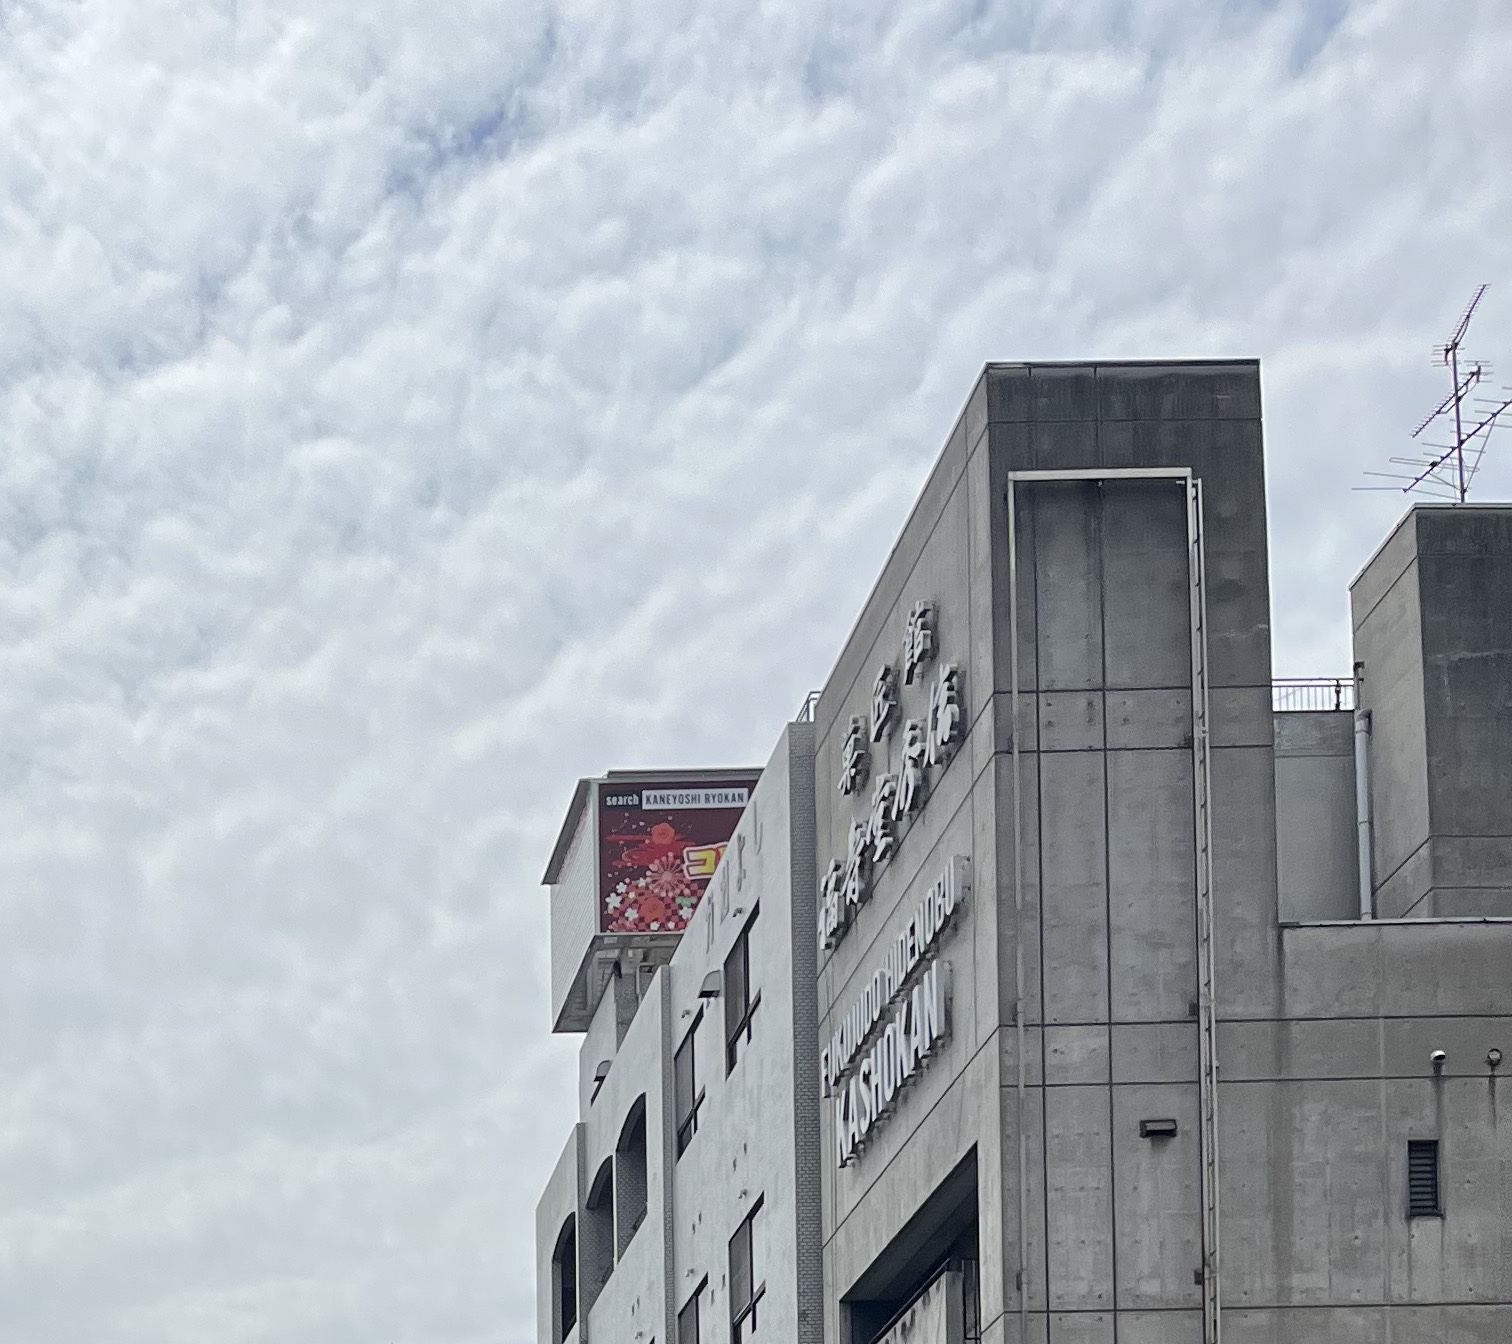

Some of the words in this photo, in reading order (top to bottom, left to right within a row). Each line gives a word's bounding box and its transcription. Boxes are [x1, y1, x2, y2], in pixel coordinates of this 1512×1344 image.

[606, 794, 639, 806] search
[645, 793, 701, 805] KANEYOSHI
[705, 791, 745, 804] RYOKAN
[838, 958, 940, 1168] KASHOKAN
